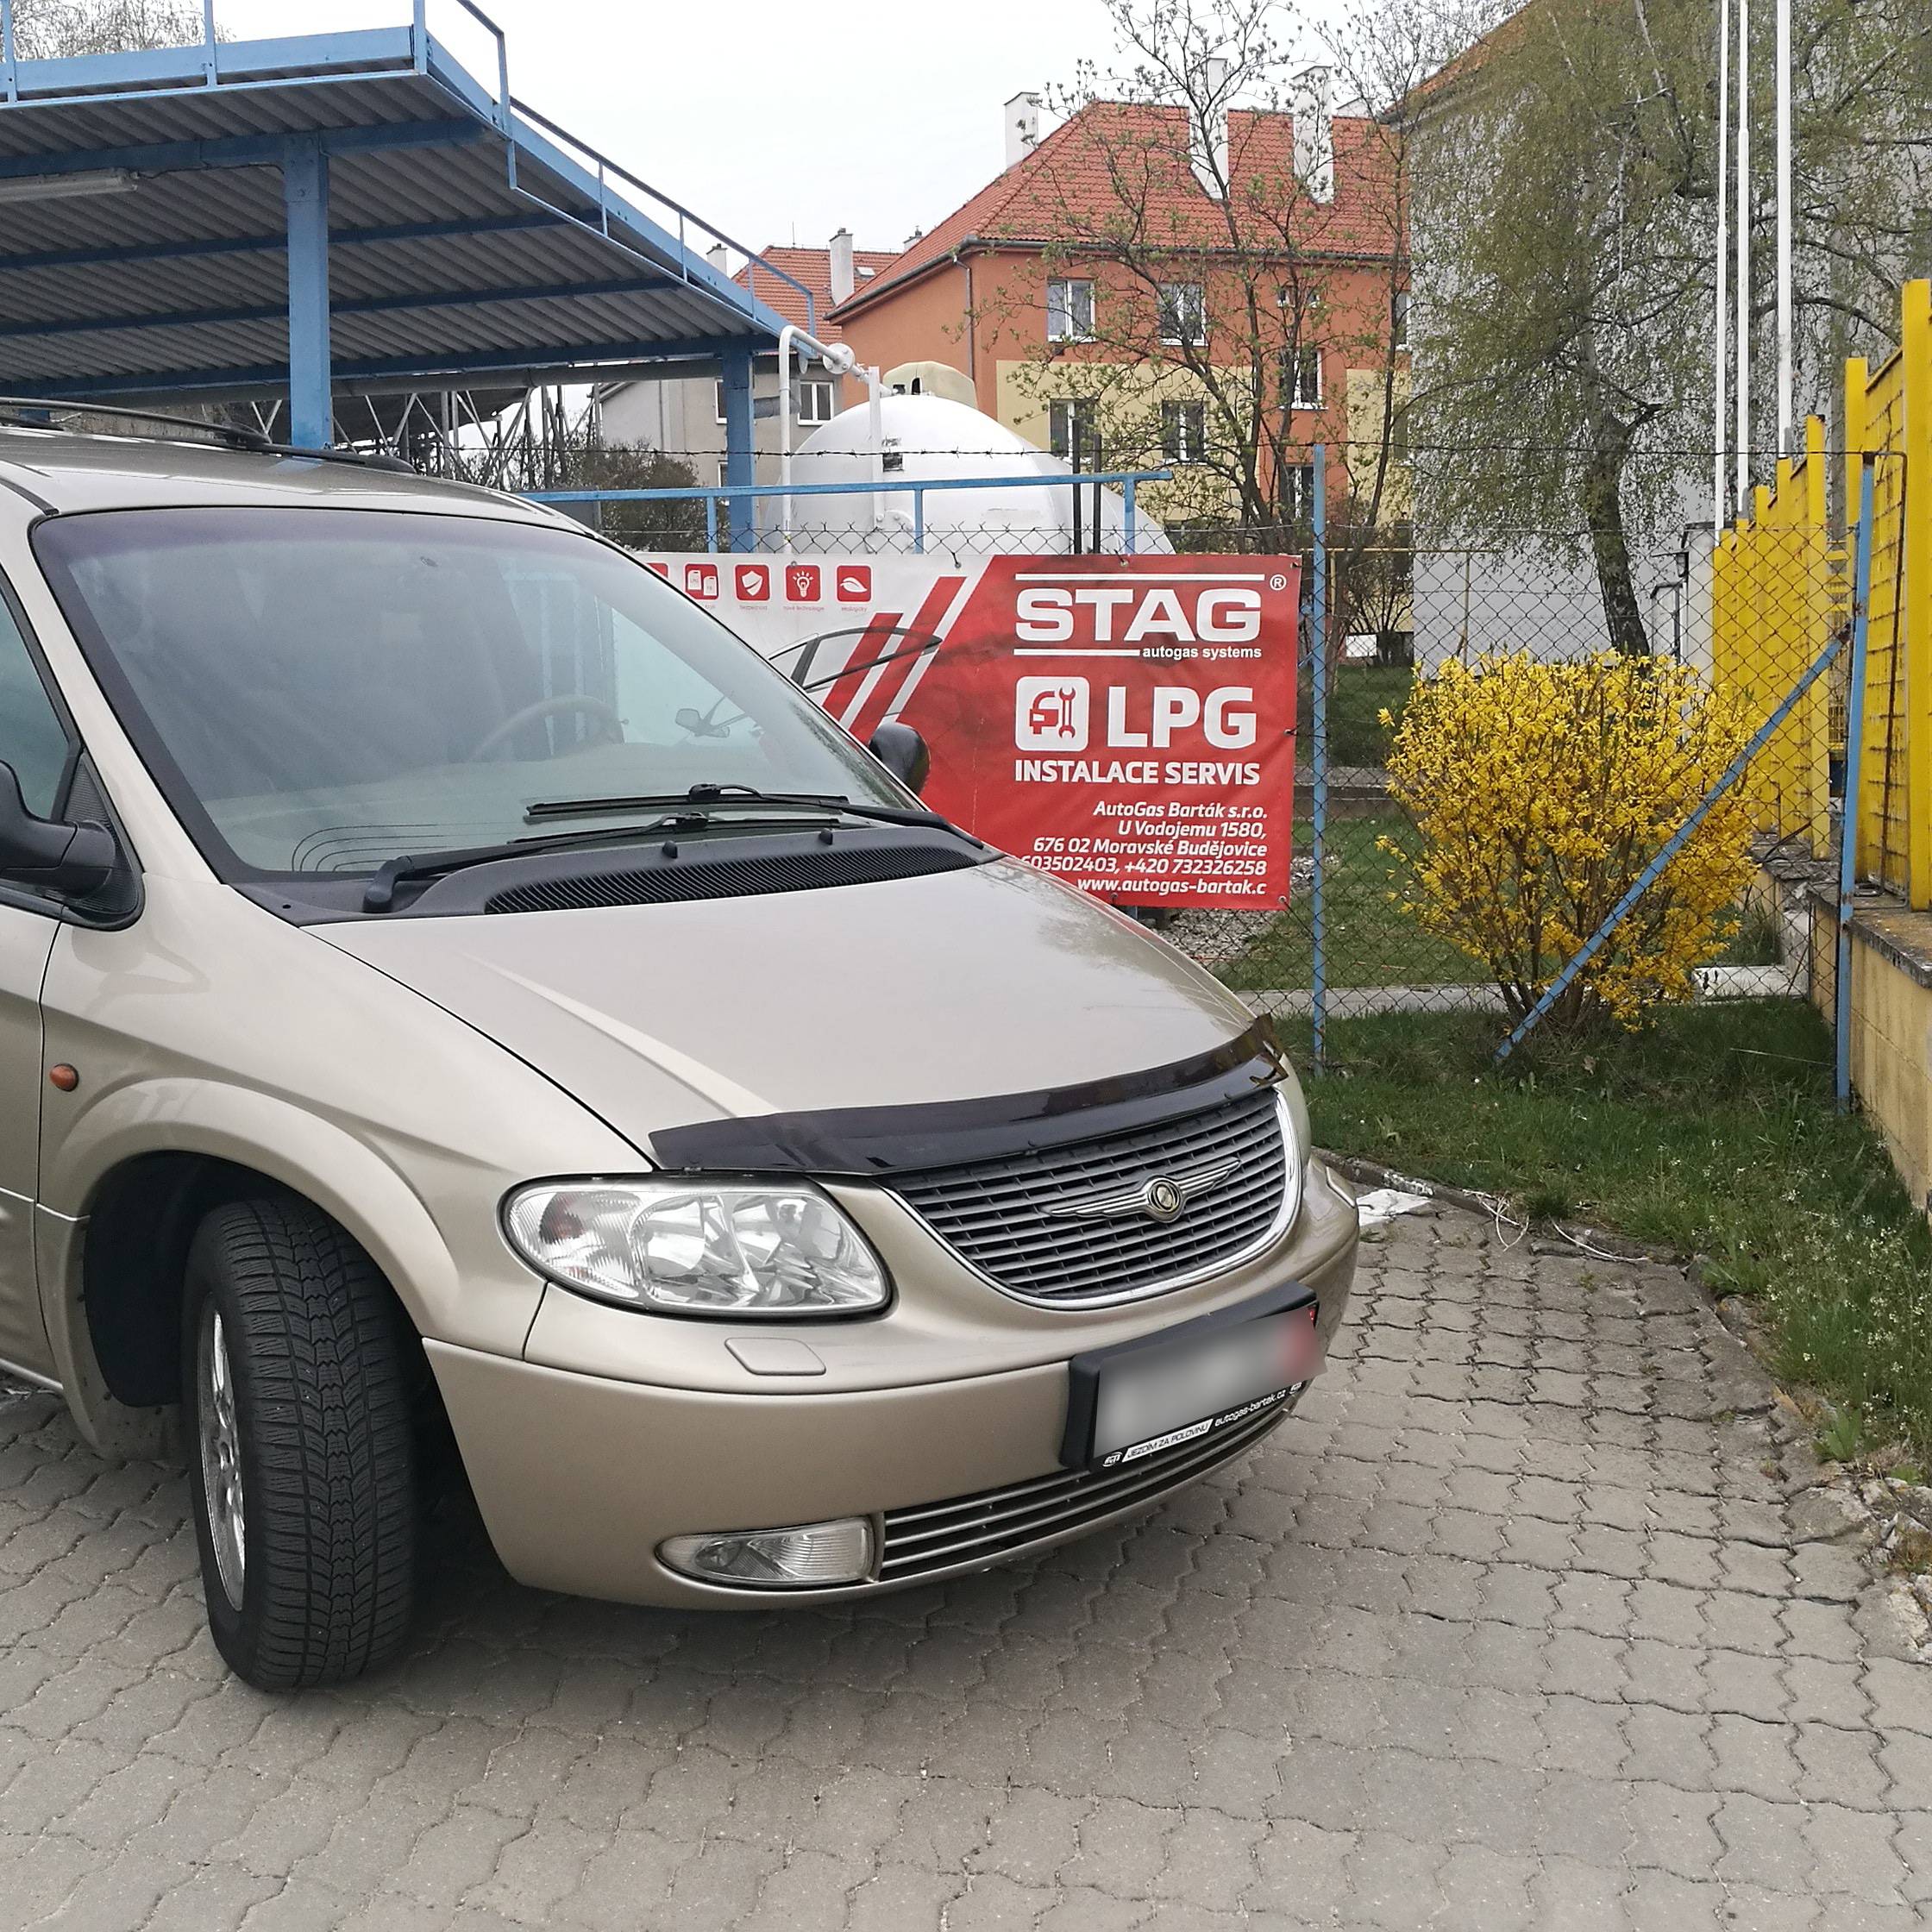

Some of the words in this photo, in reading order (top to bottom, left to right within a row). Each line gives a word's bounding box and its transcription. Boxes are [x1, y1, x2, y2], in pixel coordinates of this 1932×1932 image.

[1015, 588, 1261, 642] STAG
[1143, 647, 1198, 659] autogas
[1202, 647, 1262, 659] systems
[1107, 686, 1257, 750] LPG
[1015, 759, 1159, 784] INSTALACE
[1164, 762, 1260, 786] SERVIS
[1093, 800, 1164, 817] AutoGas
[1168, 802, 1226, 818] Barták
[1227, 806, 1267, 819] s.r.o.
[1118, 820, 1132, 835] U
[1135, 820, 1216, 839] Vodojemu
[1220, 822, 1267, 839] 1580,
[1033, 837, 1064, 852] 676
[1068, 838, 1091, 853] 02
[1093, 838, 1174, 855] Moravské
[1177, 839, 1268, 859] Budějovice
[1125, 858, 1169, 874] +420
[1172, 859, 1268, 875] 732326258
[1077, 878, 1267, 896] www.autogas-bartak.c
